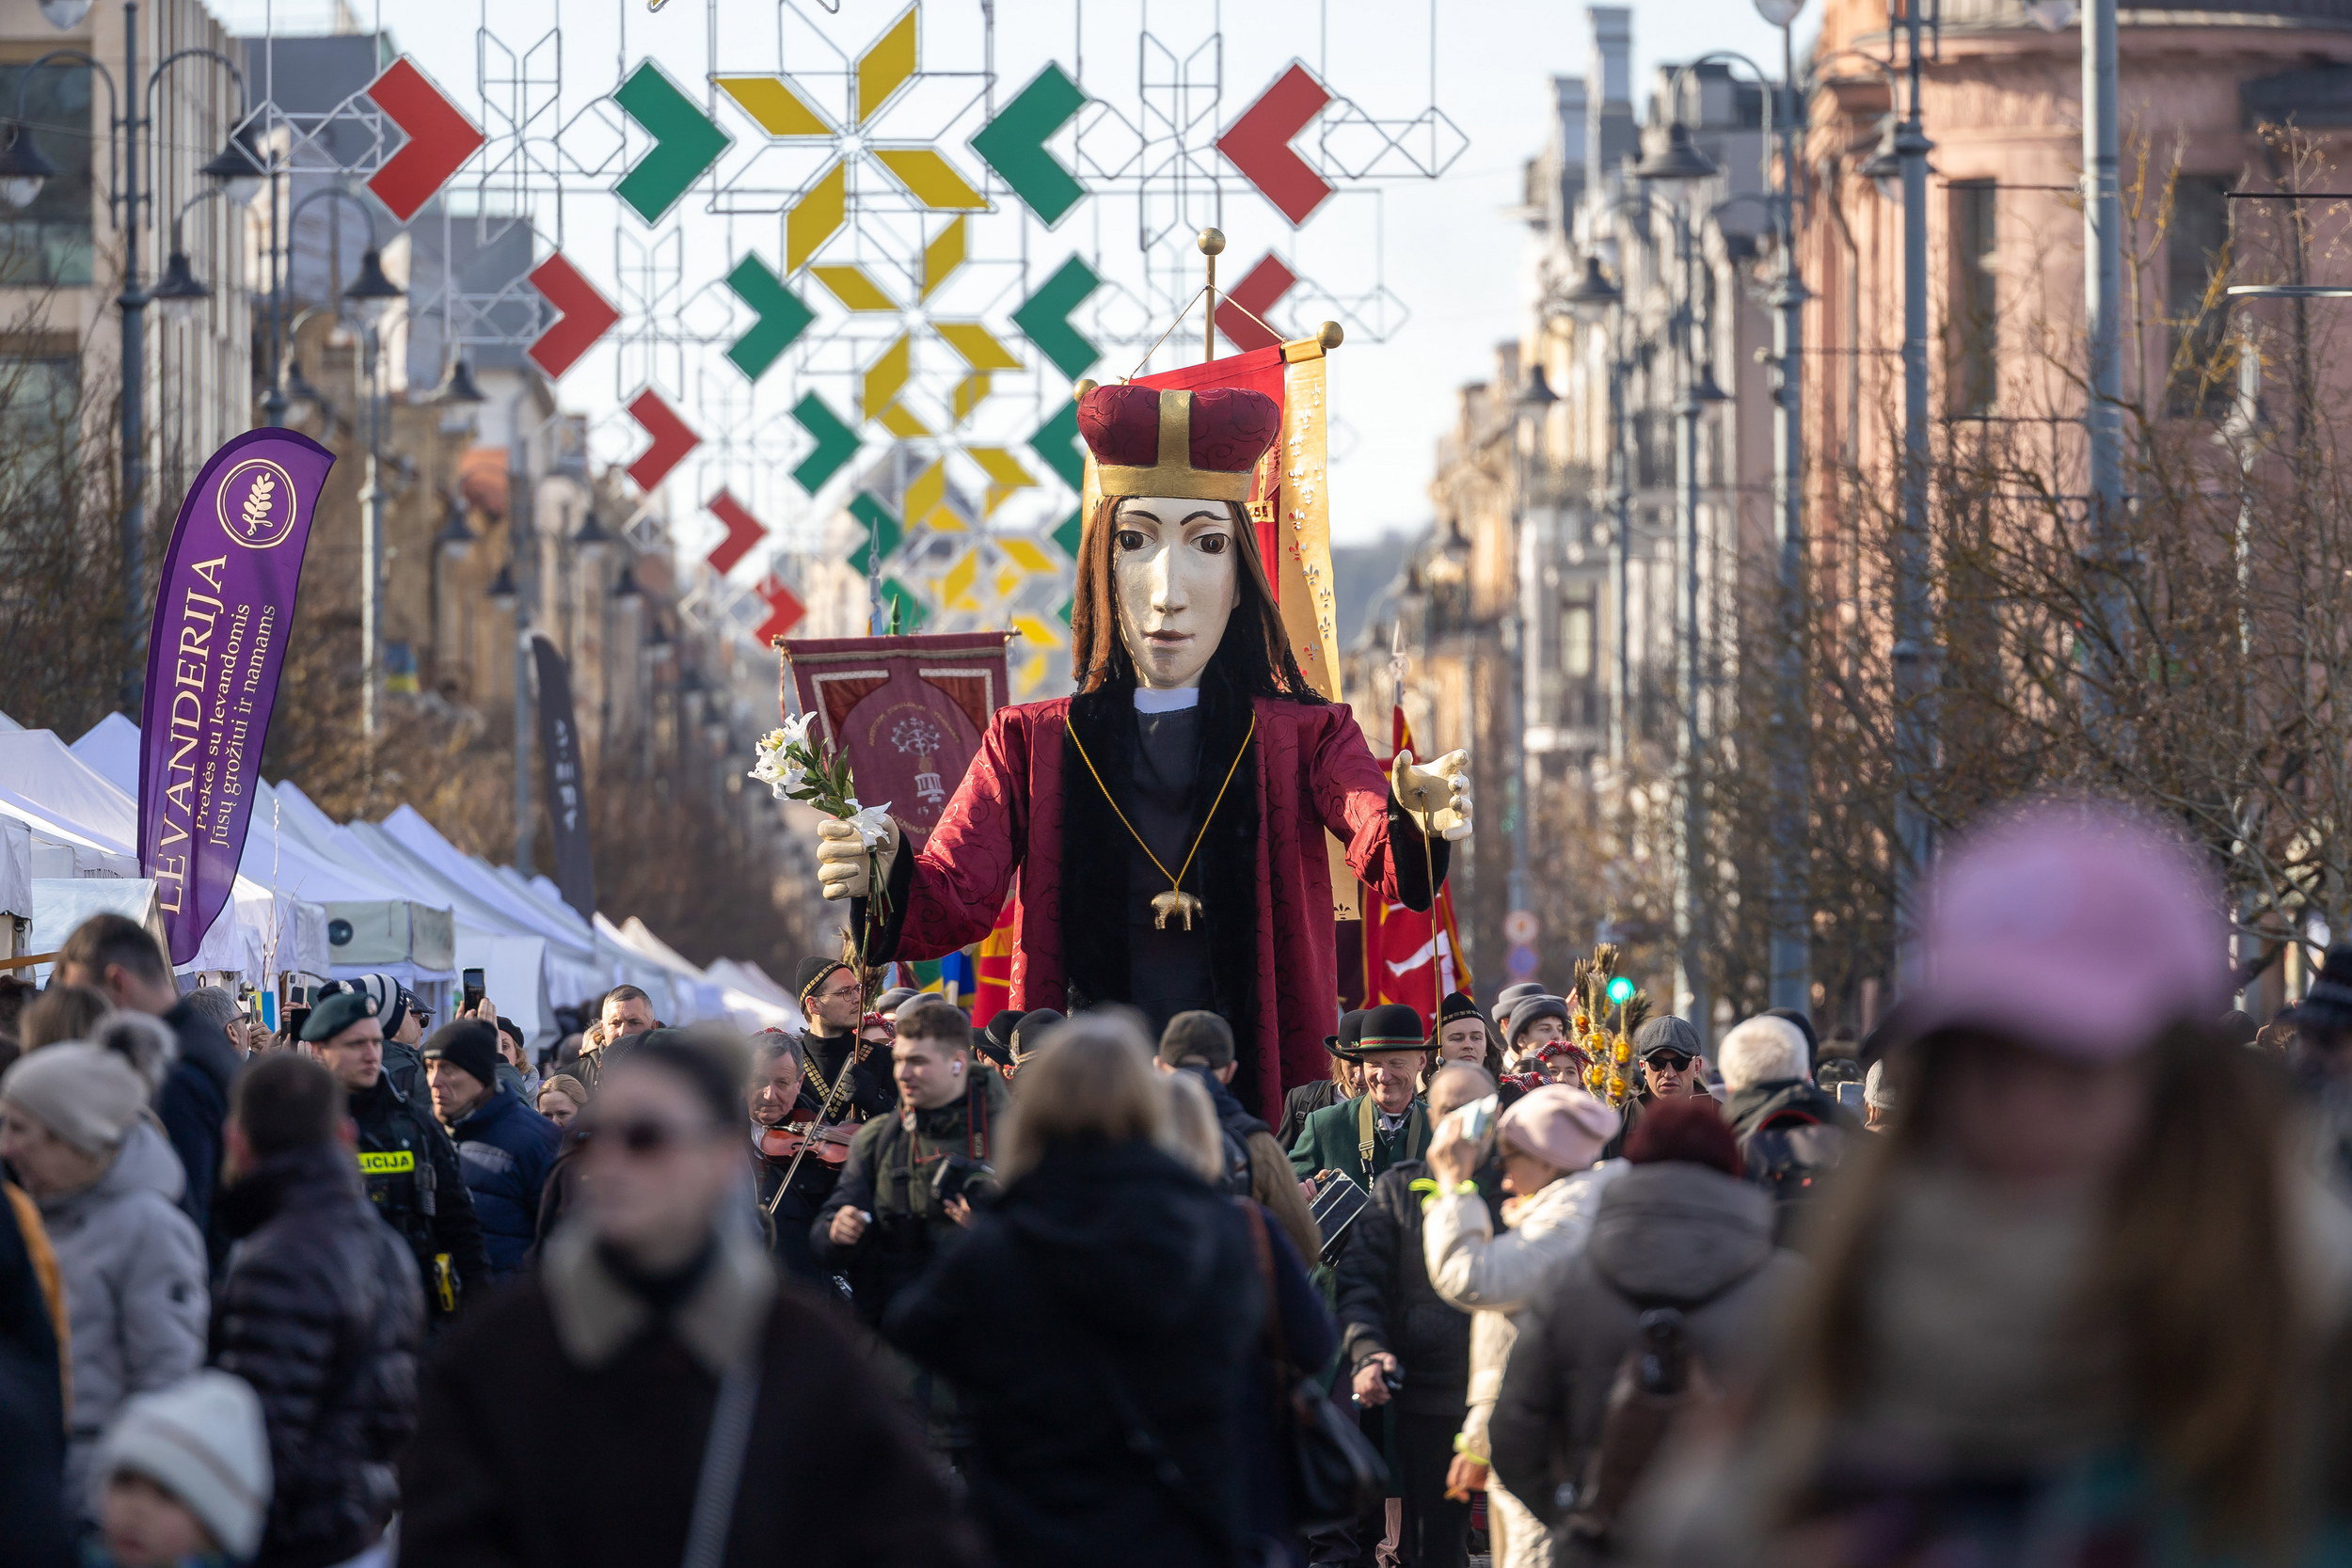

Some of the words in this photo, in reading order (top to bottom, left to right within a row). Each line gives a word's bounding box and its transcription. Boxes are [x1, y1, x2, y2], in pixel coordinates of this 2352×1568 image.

[210, 604, 250, 725] levandomis
[244, 605, 275, 693] namams
[155, 554, 228, 915] LEVANDERIJA
[233, 697, 252, 715] ir
[209, 732, 223, 756] su
[224, 719, 248, 796] grožiui
[196, 761, 216, 832] Prekės
[210, 800, 237, 848] Jūsų
